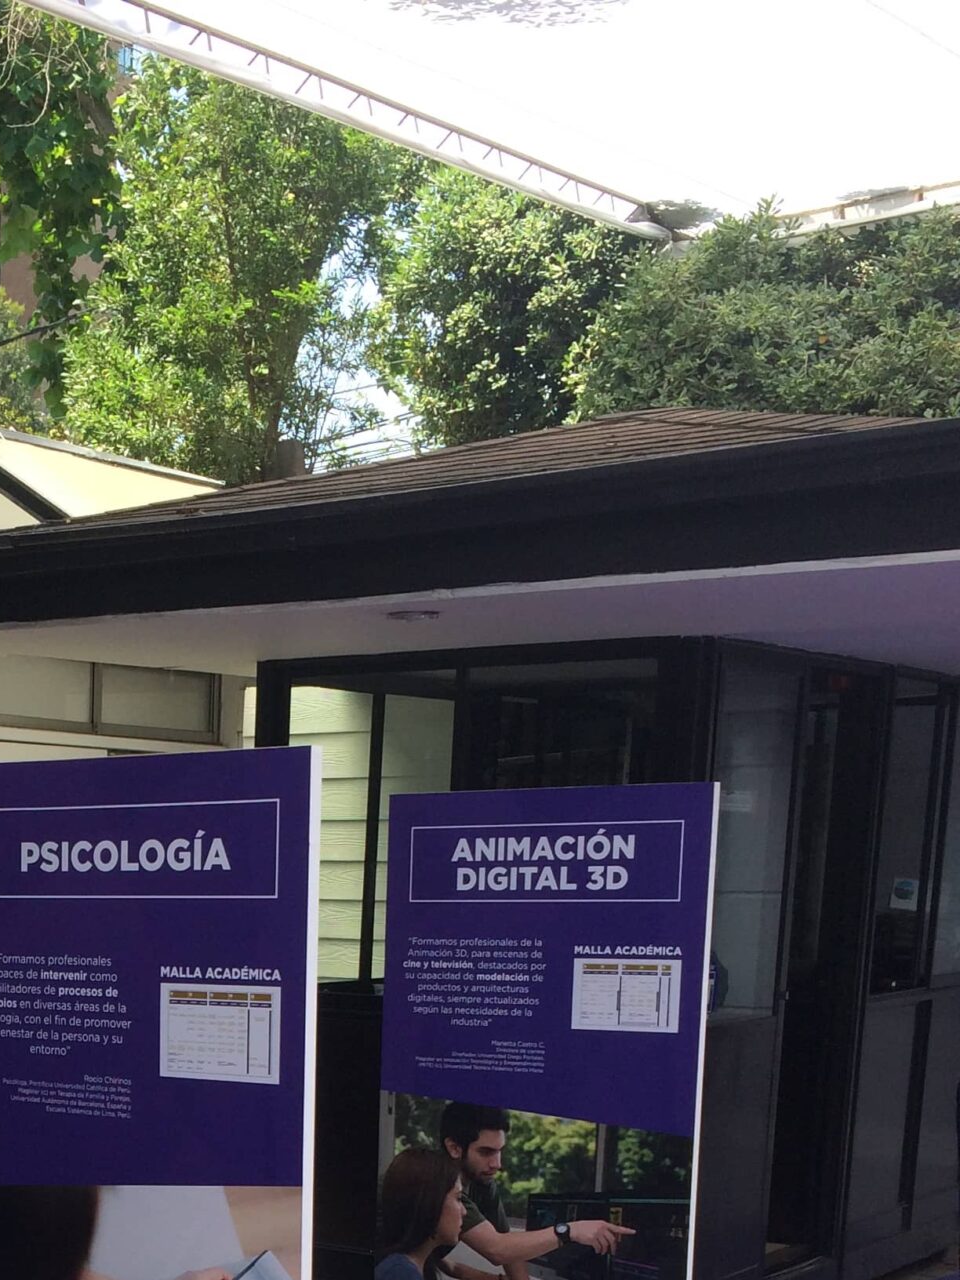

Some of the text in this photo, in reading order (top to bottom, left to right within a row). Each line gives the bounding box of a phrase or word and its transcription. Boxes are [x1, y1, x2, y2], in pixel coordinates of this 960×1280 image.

[20, 829, 231, 873] PSICOLOGÍA
[451, 828, 635, 862] ANIMACIÓN
[456, 865, 628, 891] DIGITAL 3D
[460, 938, 518, 947] profesionales
[520, 938, 532, 947] de
[534, 938, 543, 947] la
[407, 948, 453, 958] Animación
[471, 951, 491, 959] para
[493, 951, 528, 959] escenas
[530, 950, 543, 959] de
[574, 944, 682, 956] MALLA ACADÉMICA
[48, 954, 112, 967] profesionales
[402, 960, 421, 968] cine
[423, 962, 429, 970] y
[477, 961, 528, 970] destacados
[530, 963, 547, 971] por
[26, 969, 38, 979] de
[40, 969, 87, 981] intervenir
[90, 972, 118, 982] como
[160, 965, 281, 981] MALLA ACADÉMICA
[405, 970, 544, 982] su capacidad de modelación de
[44, 985, 56, 995] de
[58, 986, 103, 998] procesos
[105, 986, 119, 997] de
[417, 982, 530, 994] productos y arquitecturas
[19, 1000, 31, 1009] en
[33, 999, 72, 1011] diversas
[74, 1000, 100, 1012] áreas
[102, 1002, 115, 1013] de
[118, 1002, 127, 1014] la
[447, 996, 482, 1005] siempre
[483, 996, 540, 1006] actualizados
[413, 1004, 533, 1017] según las necesidades de la
[24, 1015, 41, 1024] con
[43, 1014, 52, 1025] el
[54, 1015, 67, 1026] fin
[69, 1016, 81, 1027] de
[84, 1018, 132, 1029] promover
[36, 1028, 49, 1040] de
[51, 1029, 59, 1041] la
[61, 1032, 101, 1043] persona
[103, 1034, 109, 1045] y
[111, 1034, 123, 1044] su
